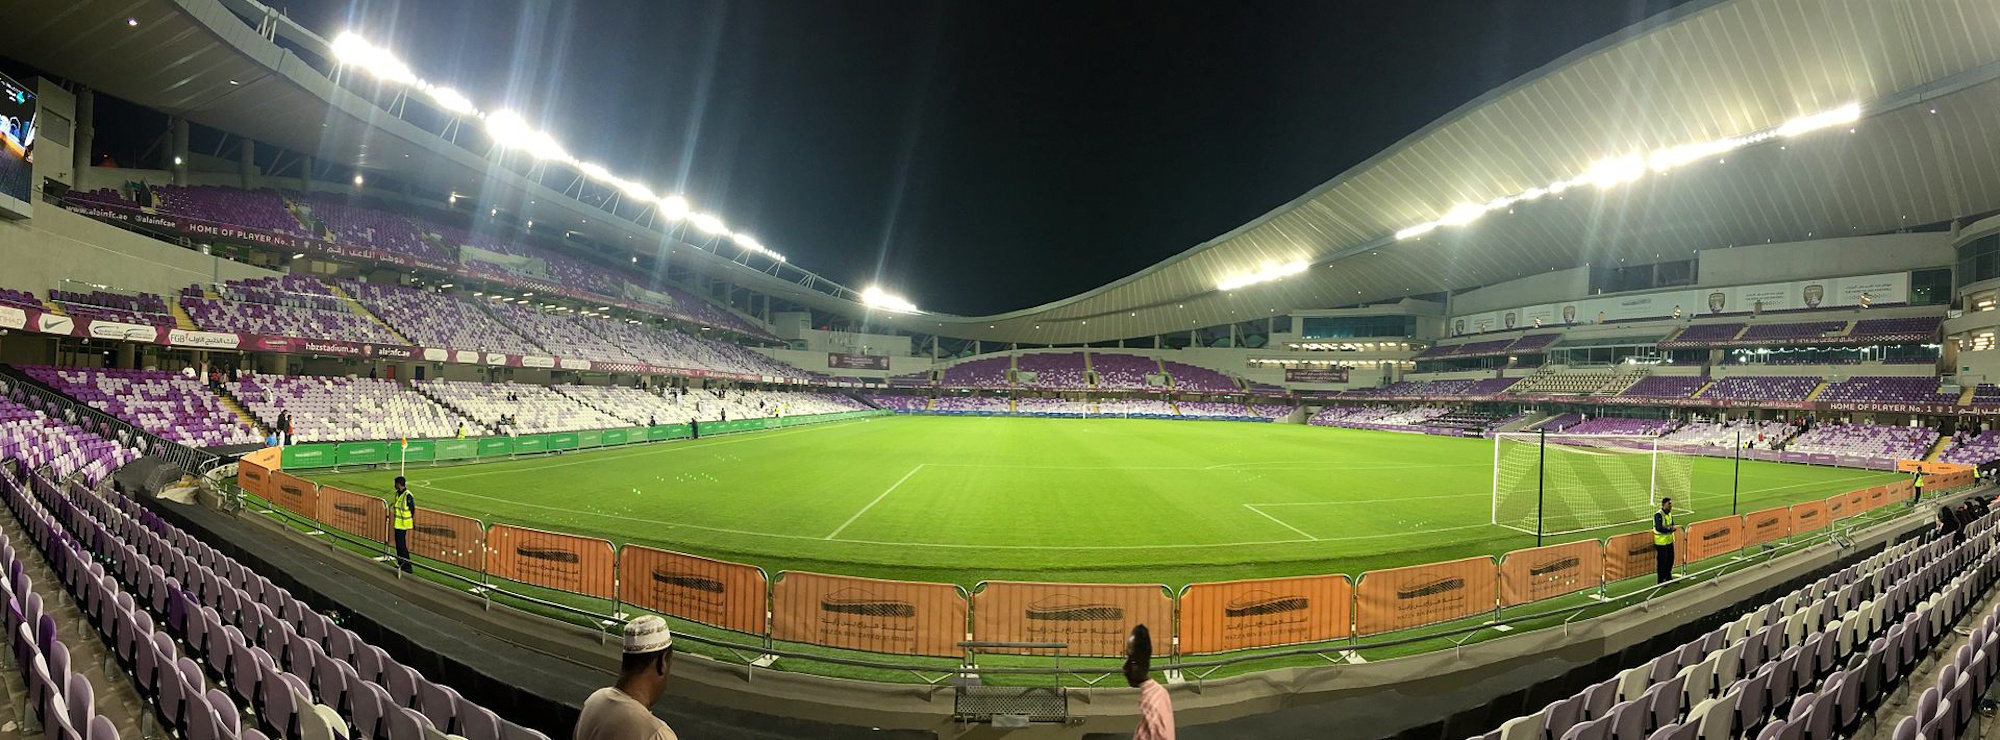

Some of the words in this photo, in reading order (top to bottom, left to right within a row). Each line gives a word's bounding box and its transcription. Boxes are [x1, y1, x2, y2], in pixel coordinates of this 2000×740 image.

[66, 205, 128, 220] www.alainfc.ae
[135, 214, 176, 228] @alainfcae
[189, 223, 218, 235] HOME
[221, 228, 235, 237] OF
[237, 231, 271, 243] PLAYER
[274, 237, 288, 246] No.
[326, 246, 345, 256] رقم
[171, 334, 184, 343] FGB
[305, 343, 359, 354] hbzstadium.ae
[1831, 403, 1855, 411] HOME
[1872, 404, 1906, 412] PLAYER
[1958, 406, 1980, 416] رقم
